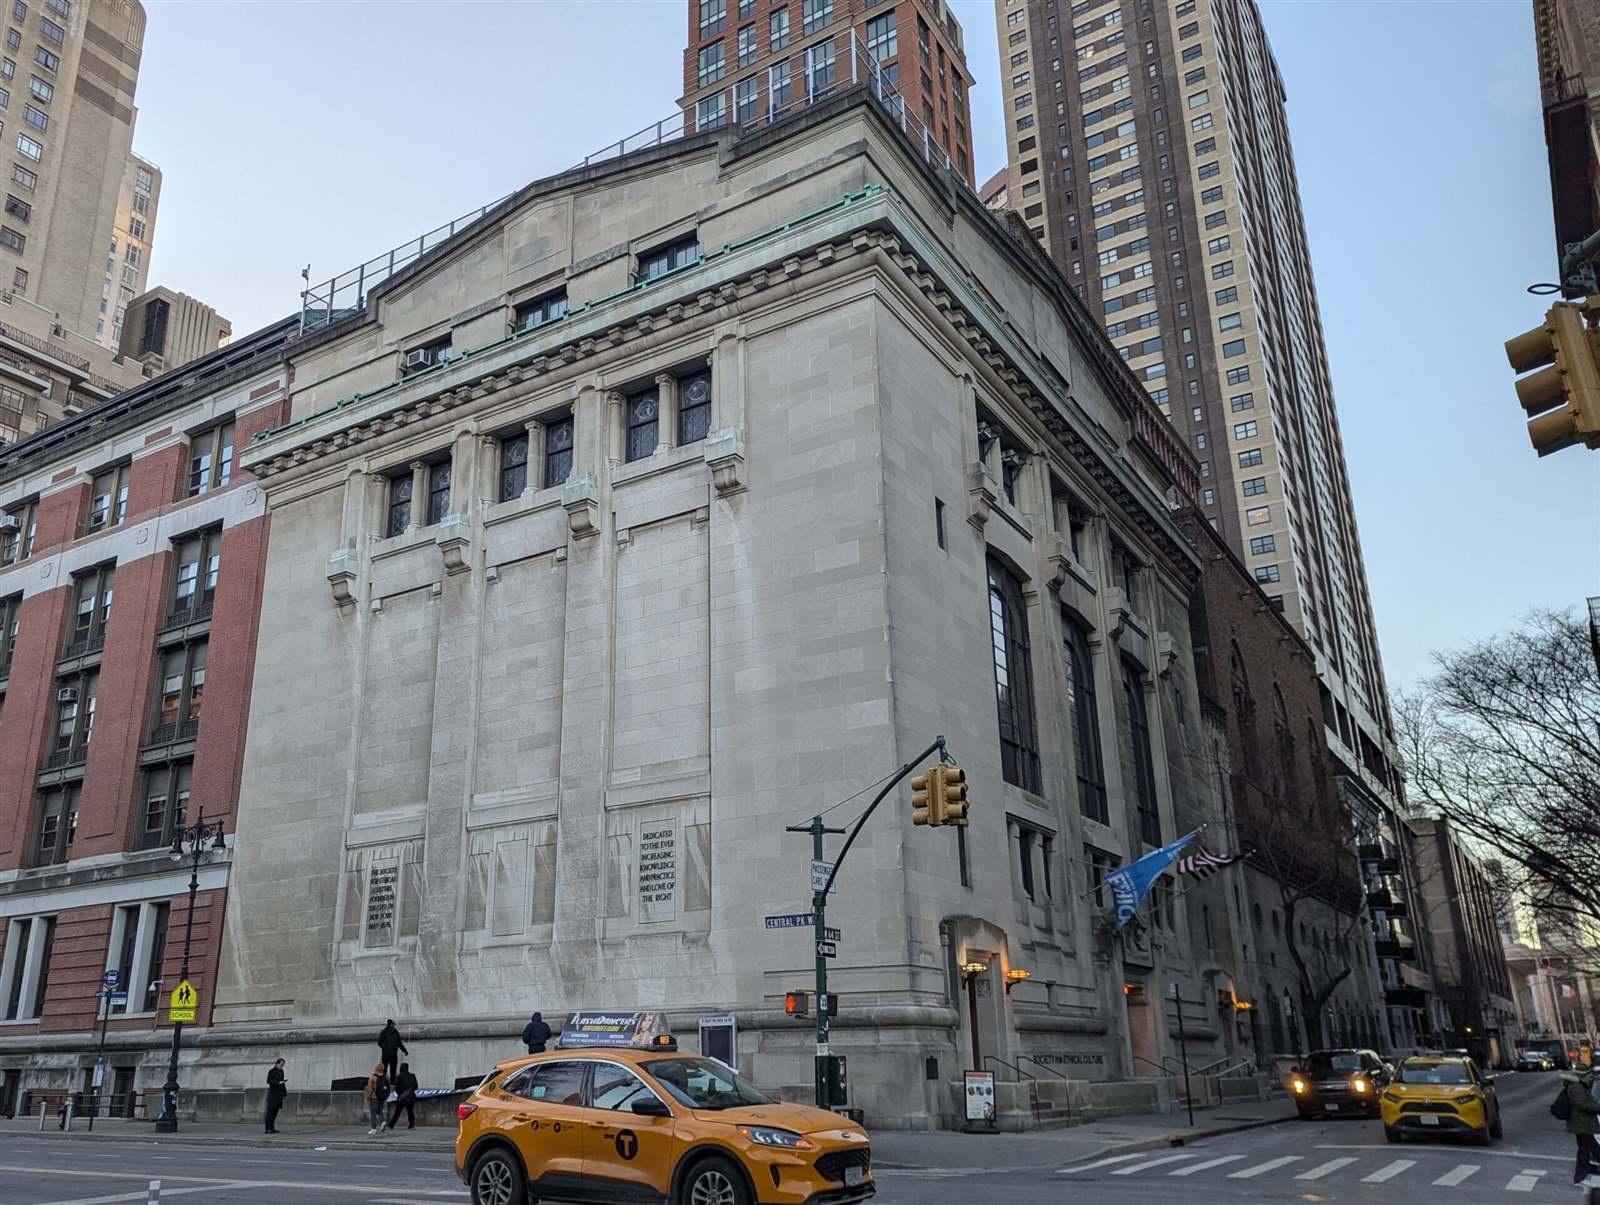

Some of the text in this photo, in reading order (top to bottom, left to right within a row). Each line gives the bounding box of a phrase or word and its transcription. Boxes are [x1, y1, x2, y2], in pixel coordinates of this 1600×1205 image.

[643, 830, 672, 840] DEDICATED
[640, 839, 674, 851] TO THE EVER
[641, 851, 674, 861] INCREASING
[640, 861, 675, 873] KNOWLEDGE
[812, 863, 833, 876] PASSENGE
[640, 881, 676, 893] AND LOVE OF
[642, 893, 673, 903] THE RIGHT
[767, 917, 794, 928] CENTRAL
[796, 916, 805, 925] PK
[1032, 1055, 1055, 1065] SOCIETY
[1063, 1055, 1083, 1065] ETHICAL
[1083, 1055, 1104, 1065] CULTURE
[620, 1135, 633, 1157] T
